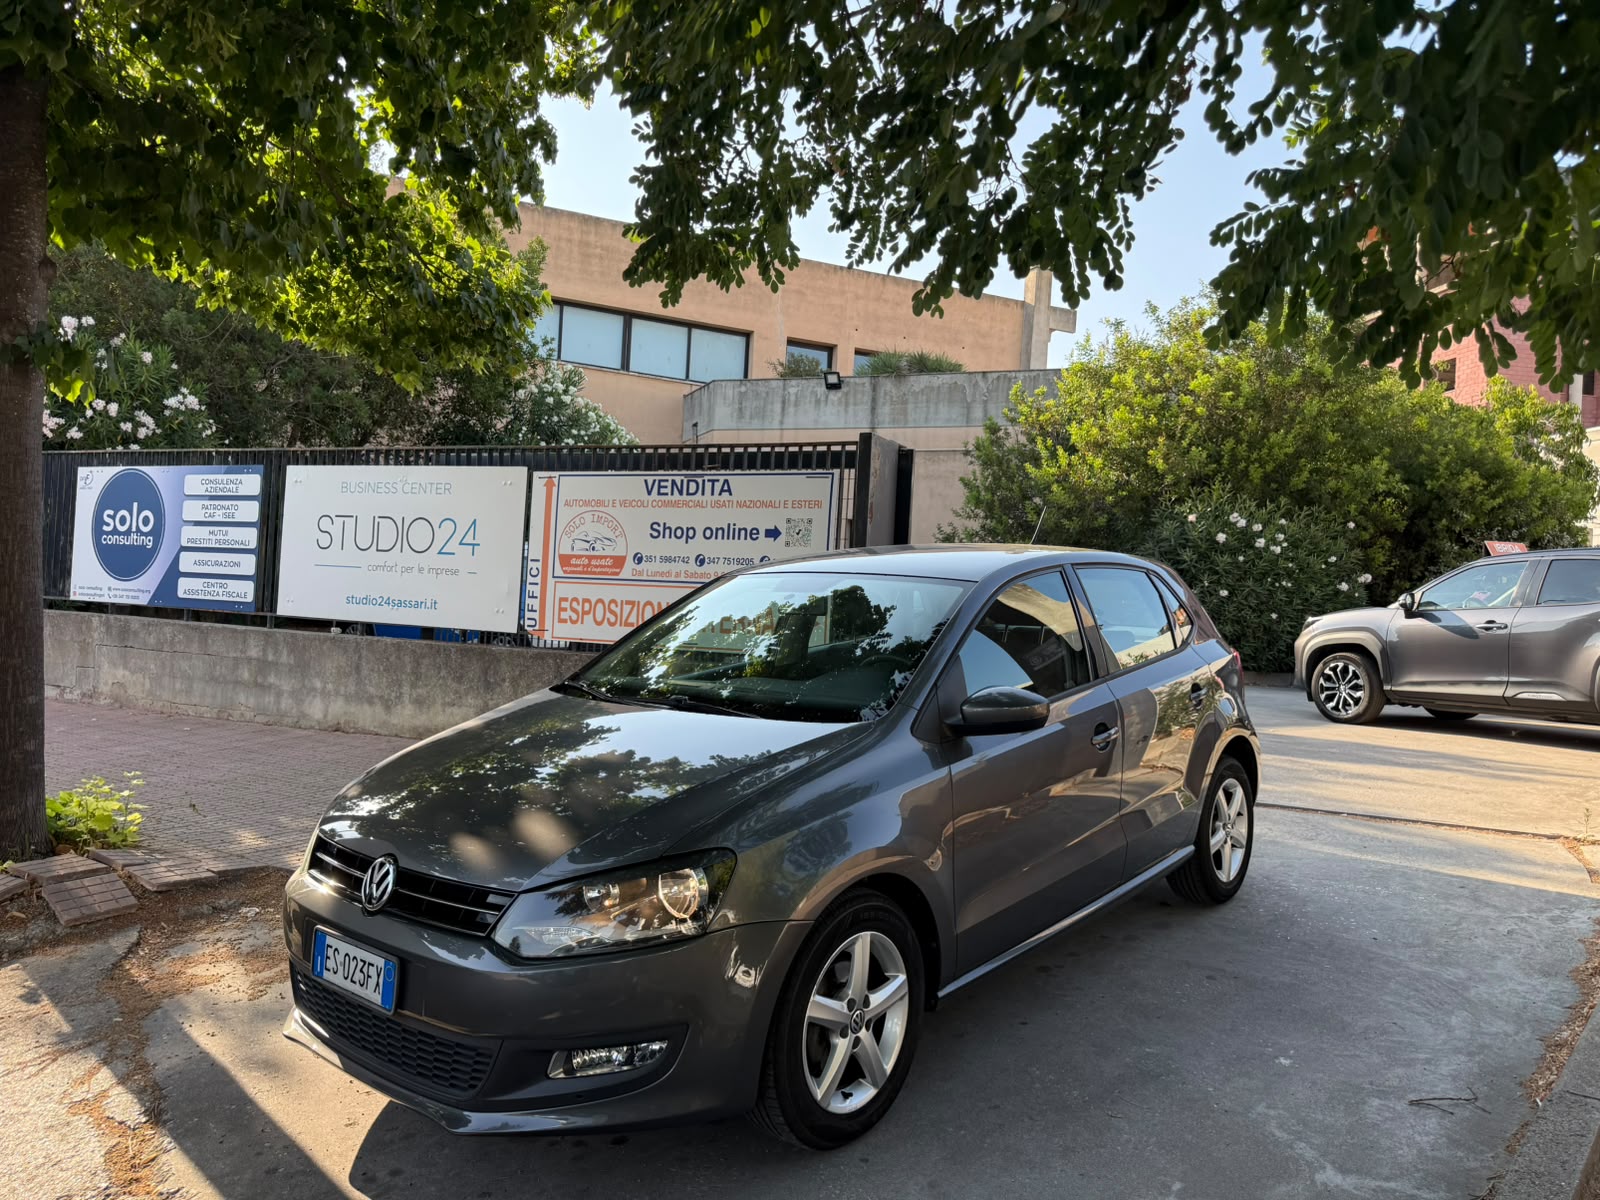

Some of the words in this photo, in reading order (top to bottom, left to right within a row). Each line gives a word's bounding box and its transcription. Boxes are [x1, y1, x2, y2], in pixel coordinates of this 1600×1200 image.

[200, 478, 243, 486] CONSULENZA
[340, 481, 398, 494] BUSINESS
[402, 482, 452, 496] CENTER
[644, 478, 733, 496] VENDITA
[564, 498, 610, 508] AUTOMOBILI
[612, 499, 617, 508] E
[618, 499, 650, 508] VEICOLI
[651, 499, 708, 509] COMMERCIALI
[710, 500, 734, 509] USATI
[736, 500, 780, 509] NAZIONALI
[784, 500, 790, 509] E
[791, 500, 822, 510] ESTERI
[102, 502, 154, 532] solo
[564, 516, 586, 539] SOLO
[591, 513, 624, 539] IMPORT
[316, 514, 480, 556] STUDIO24
[649, 522, 696, 544] Shop
[702, 522, 760, 540] online
[101, 532, 154, 548] consulting
[186, 537, 213, 545] PRESTITI
[214, 538, 250, 547] PERSONALI
[192, 559, 241, 568] ASSICURAZIONI
[570, 556, 589, 565] auto
[590, 558, 614, 566] usate
[659, 556, 690, 564] 5984742
[706, 556, 720, 564] 347
[722, 557, 754, 566] 7519205
[368, 561, 398, 572] comfort
[401, 564, 414, 576] per
[418, 563, 425, 574] le
[428, 565, 460, 579] imprese
[632, 568, 644, 577] Dal
[674, 570, 682, 578] al
[684, 570, 712, 580] Sabato
[202, 581, 228, 590] CENTRO
[182, 588, 220, 597] ASSISTENZA
[222, 590, 248, 599] FISCALE
[526, 558, 540, 629] UFFICI
[346, 594, 438, 610] studio24sassari.it
